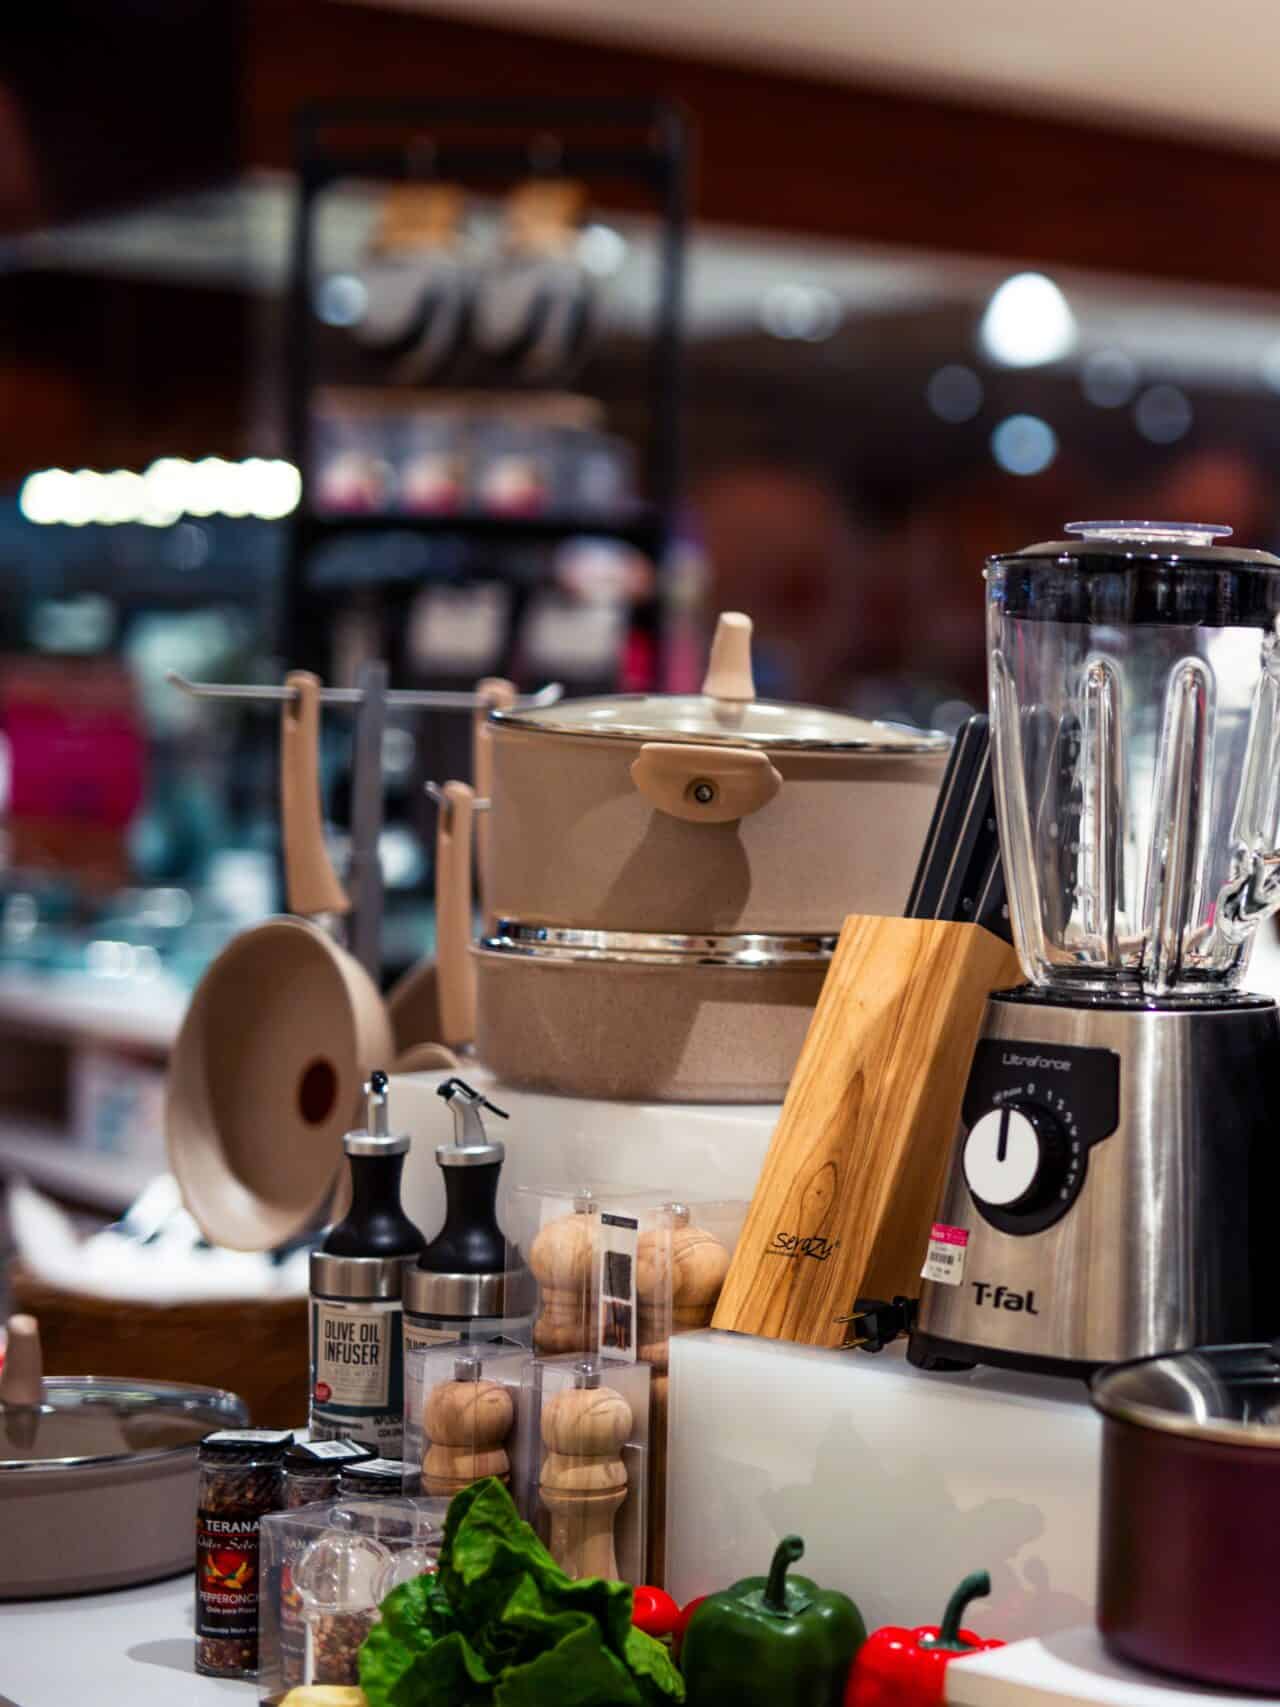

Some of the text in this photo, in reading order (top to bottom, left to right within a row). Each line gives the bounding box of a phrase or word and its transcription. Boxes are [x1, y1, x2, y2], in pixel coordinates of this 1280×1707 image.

[1002, 1053, 1072, 1071] Ultraforce
[972, 1282, 1040, 1315] T-fal
[324, 1319, 381, 1344] OLIVE OIL
[324, 1341, 379, 1366] INFUSER
[205, 1519, 260, 1533] TERANA
